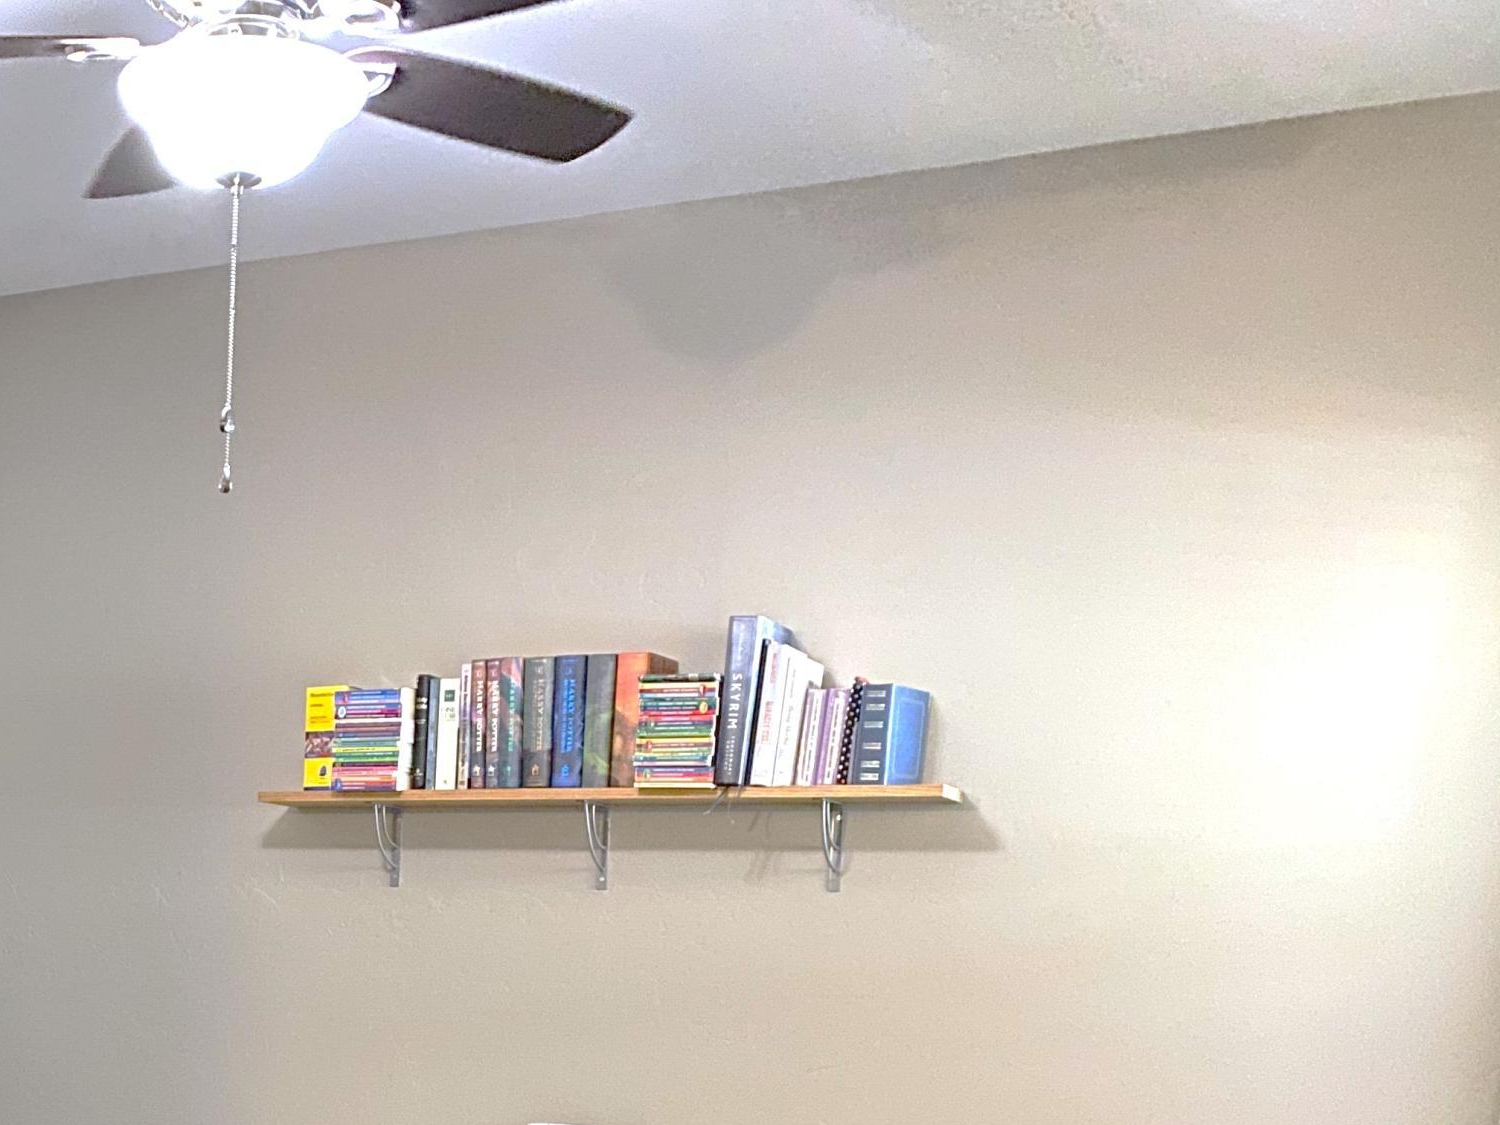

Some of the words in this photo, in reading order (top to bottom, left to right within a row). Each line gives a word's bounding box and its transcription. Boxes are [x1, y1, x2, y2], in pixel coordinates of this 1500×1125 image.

[491, 680, 499, 715] HARRY
[537, 679, 545, 715] HARRY
[567, 679, 576, 715] HARRY
[727, 673, 743, 730] SKYRIM
